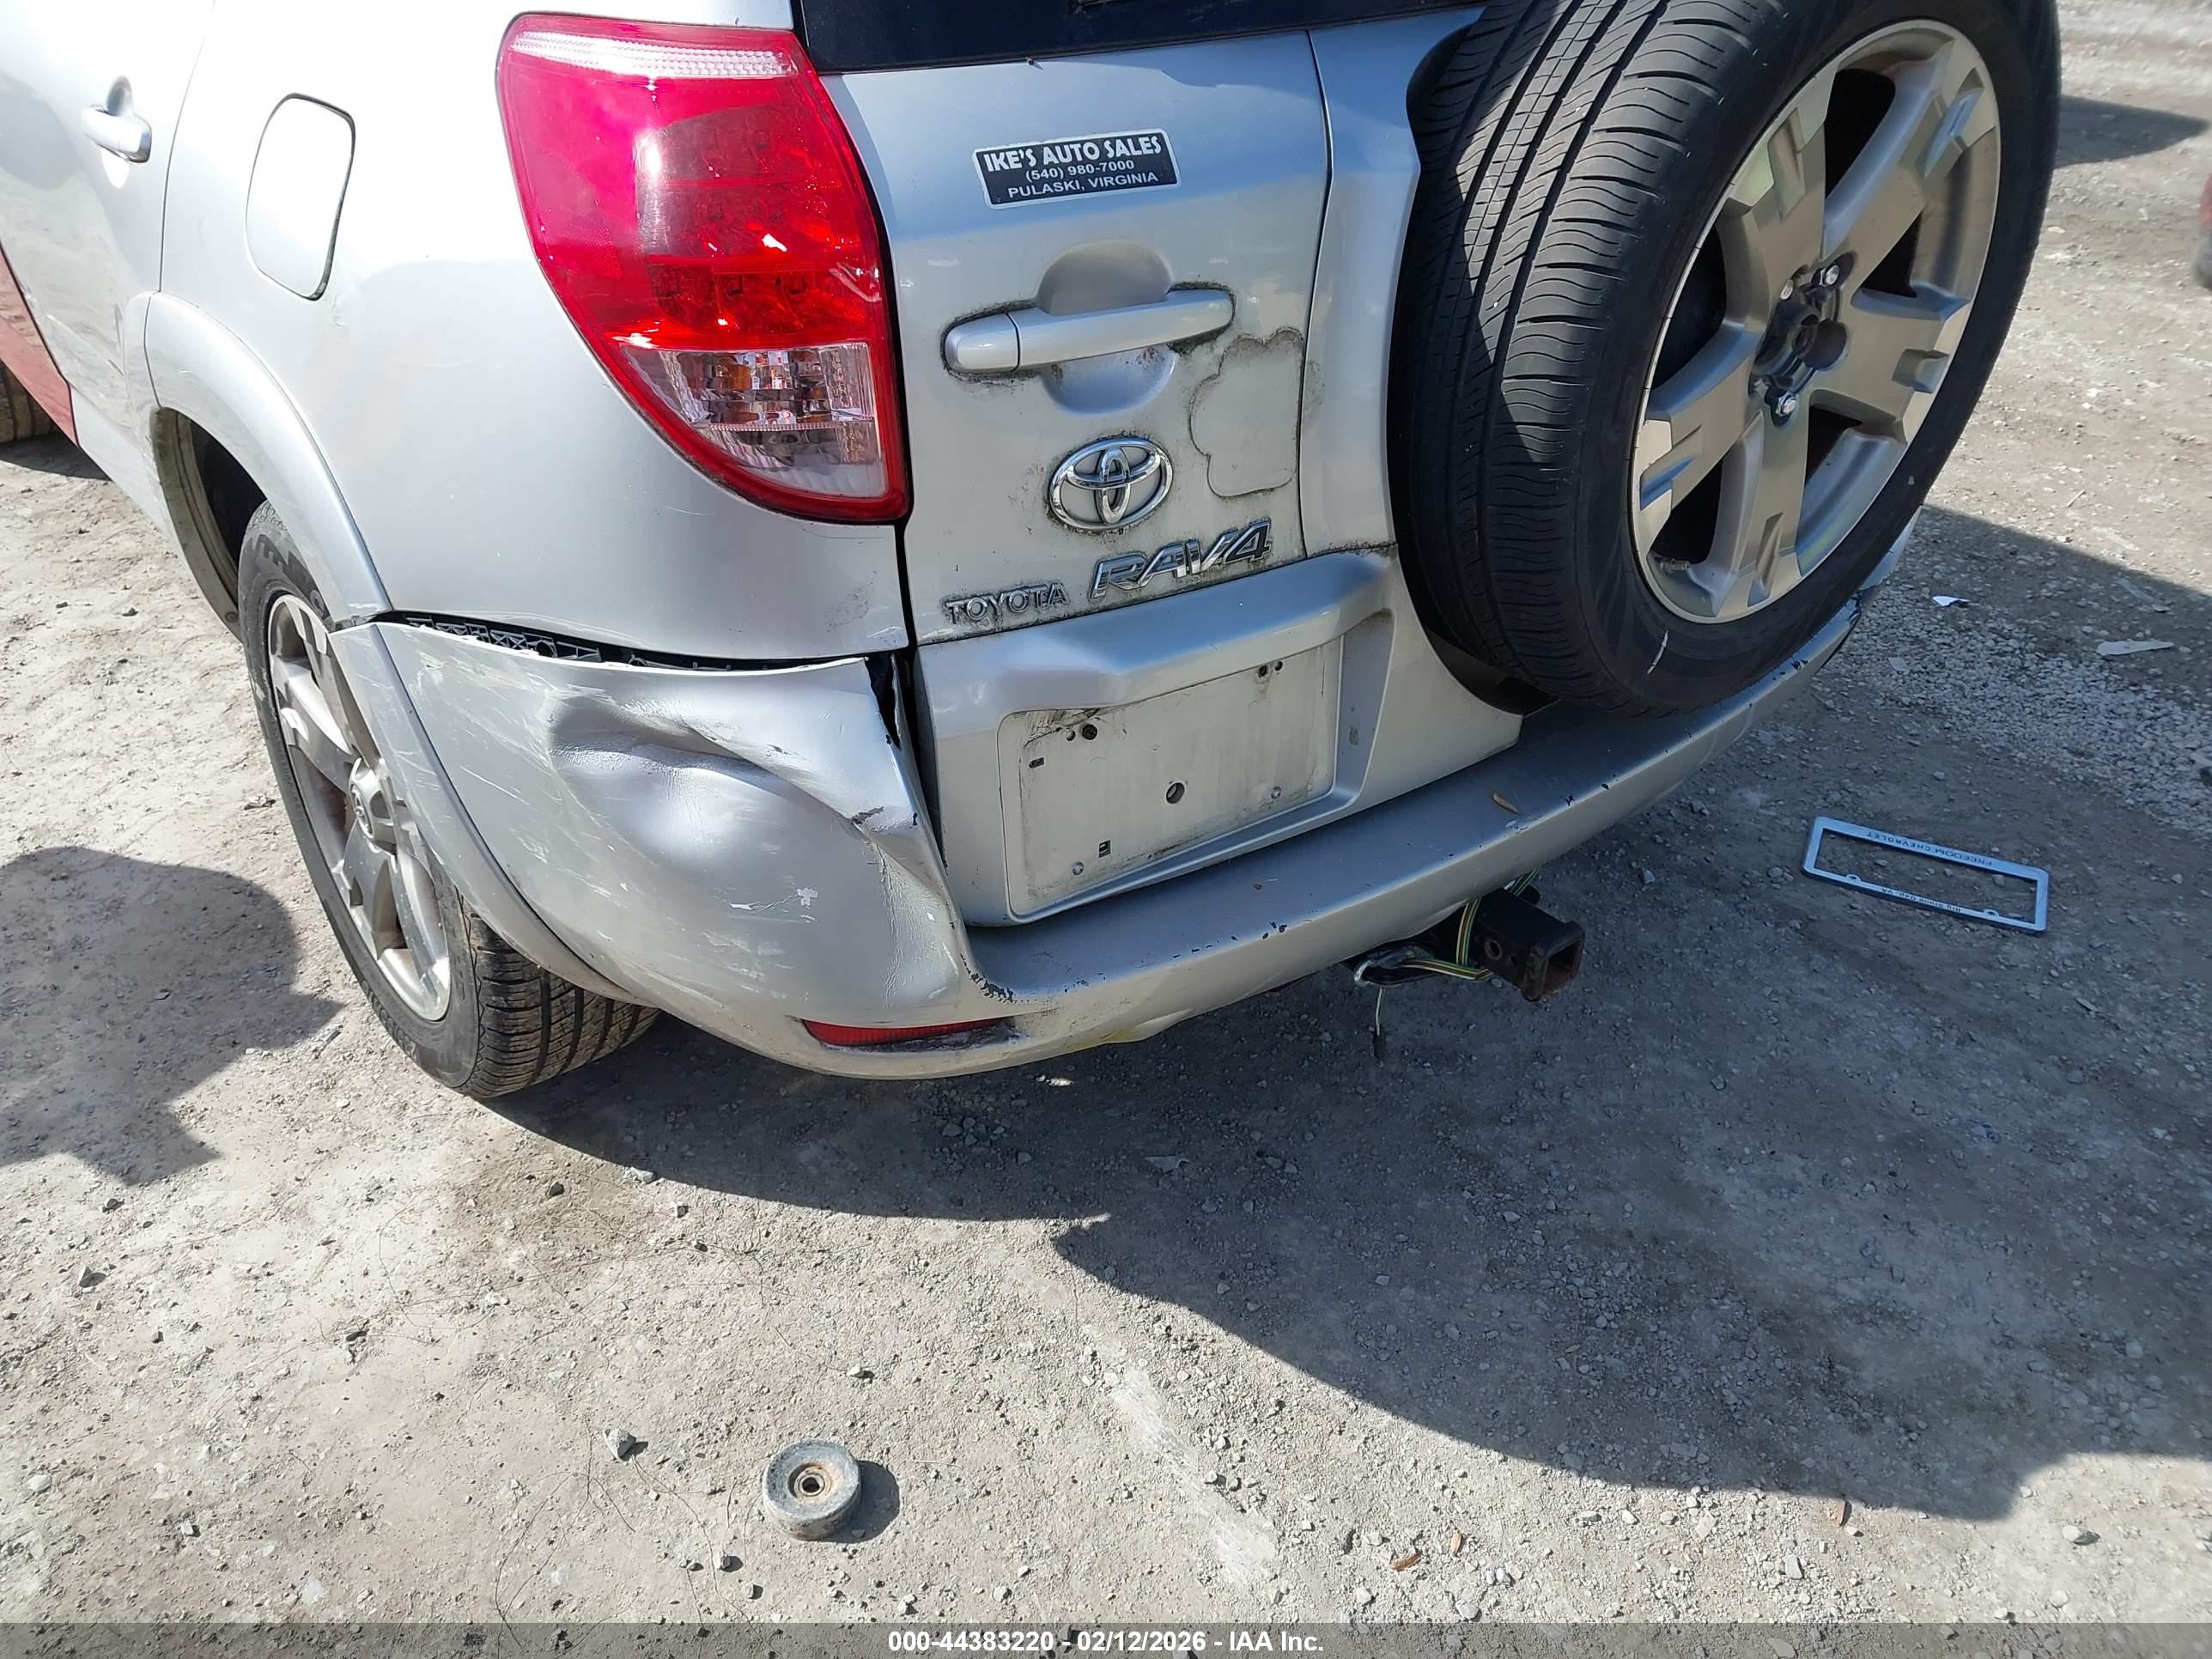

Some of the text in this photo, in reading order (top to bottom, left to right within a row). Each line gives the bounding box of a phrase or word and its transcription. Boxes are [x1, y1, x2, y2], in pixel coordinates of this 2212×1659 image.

[983, 136, 1162, 172] IKE'S AUTO SALES
[1007, 172, 1159, 198] PULASKI, VIRGINIA
[1025, 160, 1135, 183] (540) 980-7000
[1090, 519, 1272, 600] RAV4
[945, 581, 1070, 624] TOYOTA
[1868, 831, 1931, 851] CHEVROLET
